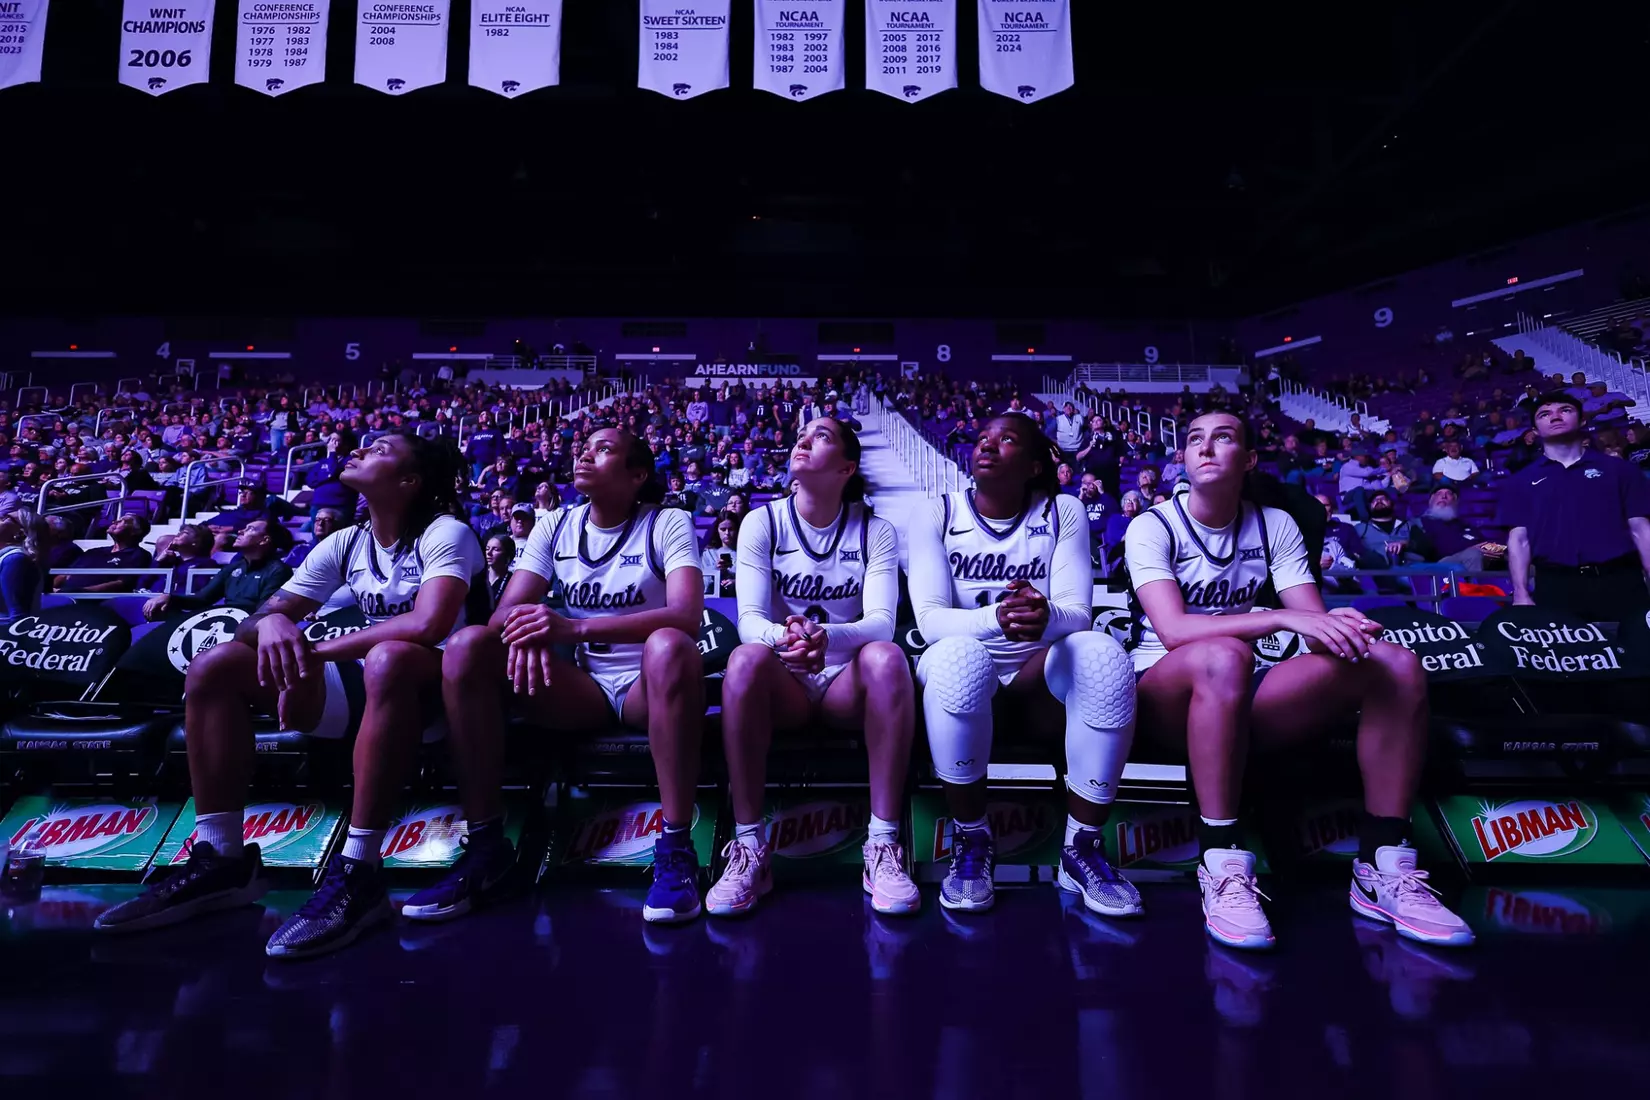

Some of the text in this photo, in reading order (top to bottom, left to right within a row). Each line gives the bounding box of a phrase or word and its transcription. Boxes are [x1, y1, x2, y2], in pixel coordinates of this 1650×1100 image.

[253, 3, 314, 12] CONFERENCE
[373, 4, 435, 13] CONFERENCE
[149, 8, 187, 19] WNIT
[243, 11, 321, 21] CHAMPIONSHIPS
[362, 12, 441, 21] CHAMPIONSHIPS
[481, 13, 550, 23] ELITE EIGHT
[779, 10, 819, 22] NCAA
[890, 11, 930, 23] NCAA
[1004, 11, 1044, 23] NCAA
[643, 15, 726, 26] SWEET SIXTEEN
[0, 24, 27, 33] 2015
[122, 20, 206, 34] CHAMPIONS
[251, 25, 311, 35] 1976 1982
[370, 26, 396, 35] 2004
[1000, 22, 1049, 30] TOURNAMENT
[485, 28, 510, 37] 1982
[655, 31, 679, 40] 1983
[770, 32, 828, 41] 1982 1997
[882, 33, 941, 42] 2005 2012
[0, 34, 25, 44] 2018
[250, 36, 310, 46] 1977 1983
[369, 36, 395, 46] 2008
[995, 33, 1021, 43] 2022
[654, 42, 679, 51] 1984
[770, 43, 828, 52] 1983 2002
[882, 44, 941, 53] 2008 2016
[996, 43, 1022, 53] 2024
[249, 47, 308, 57] 1978 1984
[653, 52, 678, 61] 2002
[127, 49, 192, 68] 2006
[247, 57, 307, 68] 1979 1987
[770, 54, 828, 63] 1984 2003
[882, 54, 941, 64] 2009 2017
[770, 64, 828, 74] 1987 2004
[882, 65, 942, 75] 2011 2019
[1373, 307, 1394, 328] 9
[156, 341, 171, 359] 4
[345, 342, 360, 360] 5
[936, 344, 951, 362] 8
[1144, 346, 1159, 364] 9
[949, 551, 1048, 581] Wildcats
[771, 569, 860, 601] Wildcats
[558, 578, 647, 609] Wildcats
[1175, 576, 1258, 608] Wildcat
[8, 616, 118, 646] Capitol
[1382, 621, 1471, 649] apitol
[1497, 621, 1608, 648] Capitol
[769, 803, 866, 852] IBMAN
[1471, 801, 1589, 862] LIBMAN
